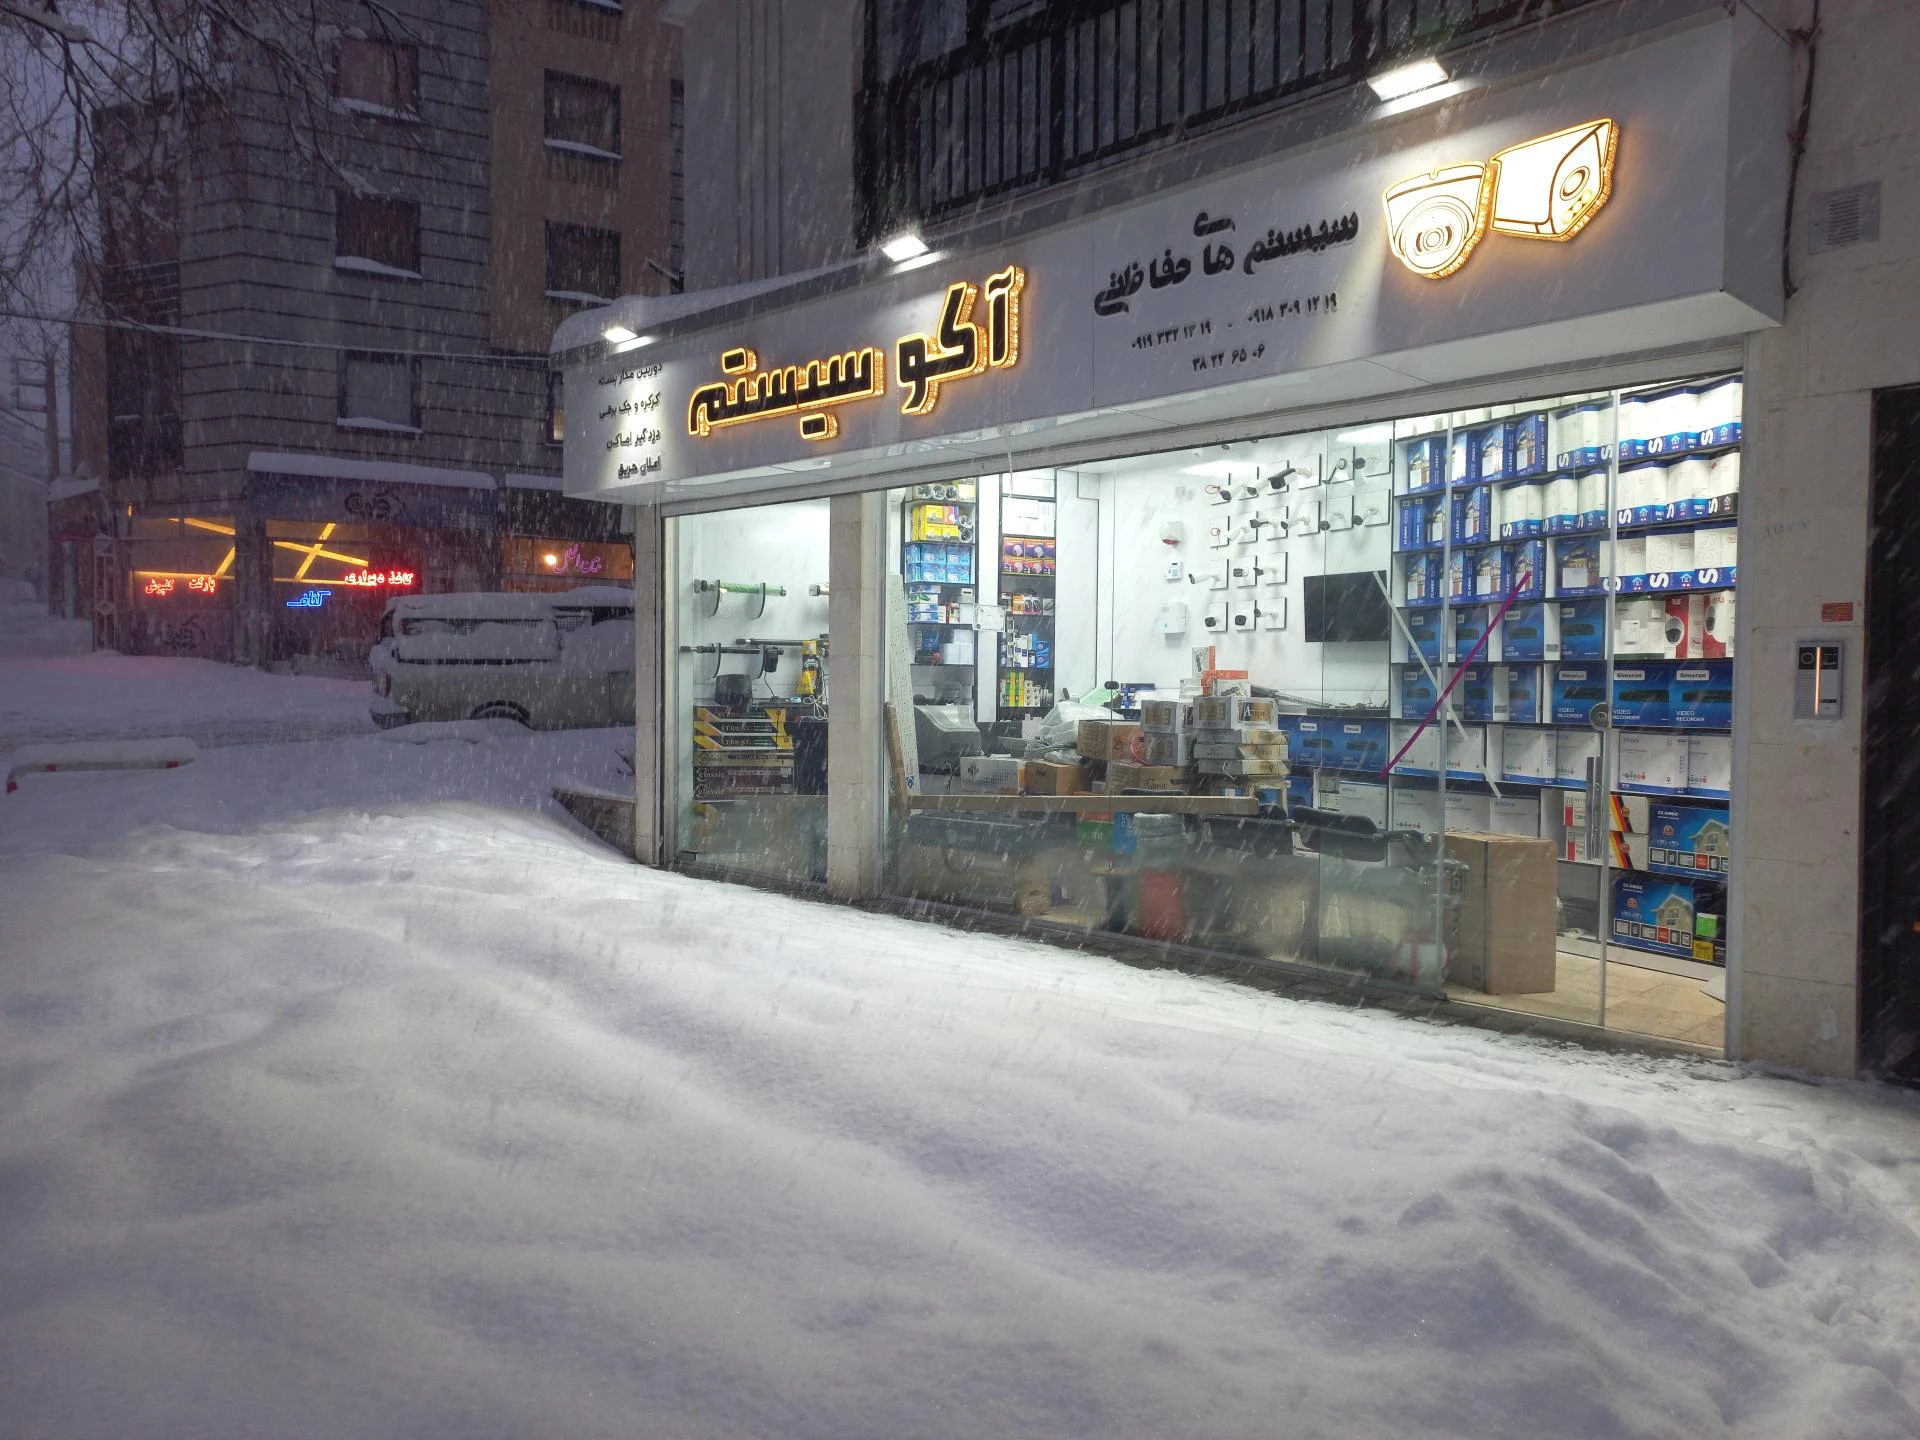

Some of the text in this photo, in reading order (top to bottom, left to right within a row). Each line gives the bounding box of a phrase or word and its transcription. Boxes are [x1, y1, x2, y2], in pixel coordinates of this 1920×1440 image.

[1243, 211, 1360, 275] سیستم
[1094, 248, 1192, 317] حفاظتی
[688, 265, 1024, 440] آکو سیستم
[619, 368, 635, 385] مدار
[637, 362, 663, 379] دوربین
[634, 402, 639, 414] و
[188, 576, 216, 594] پارکت
[388, 570, 414, 586] کاغذ
[287, 590, 331, 607] کناف
